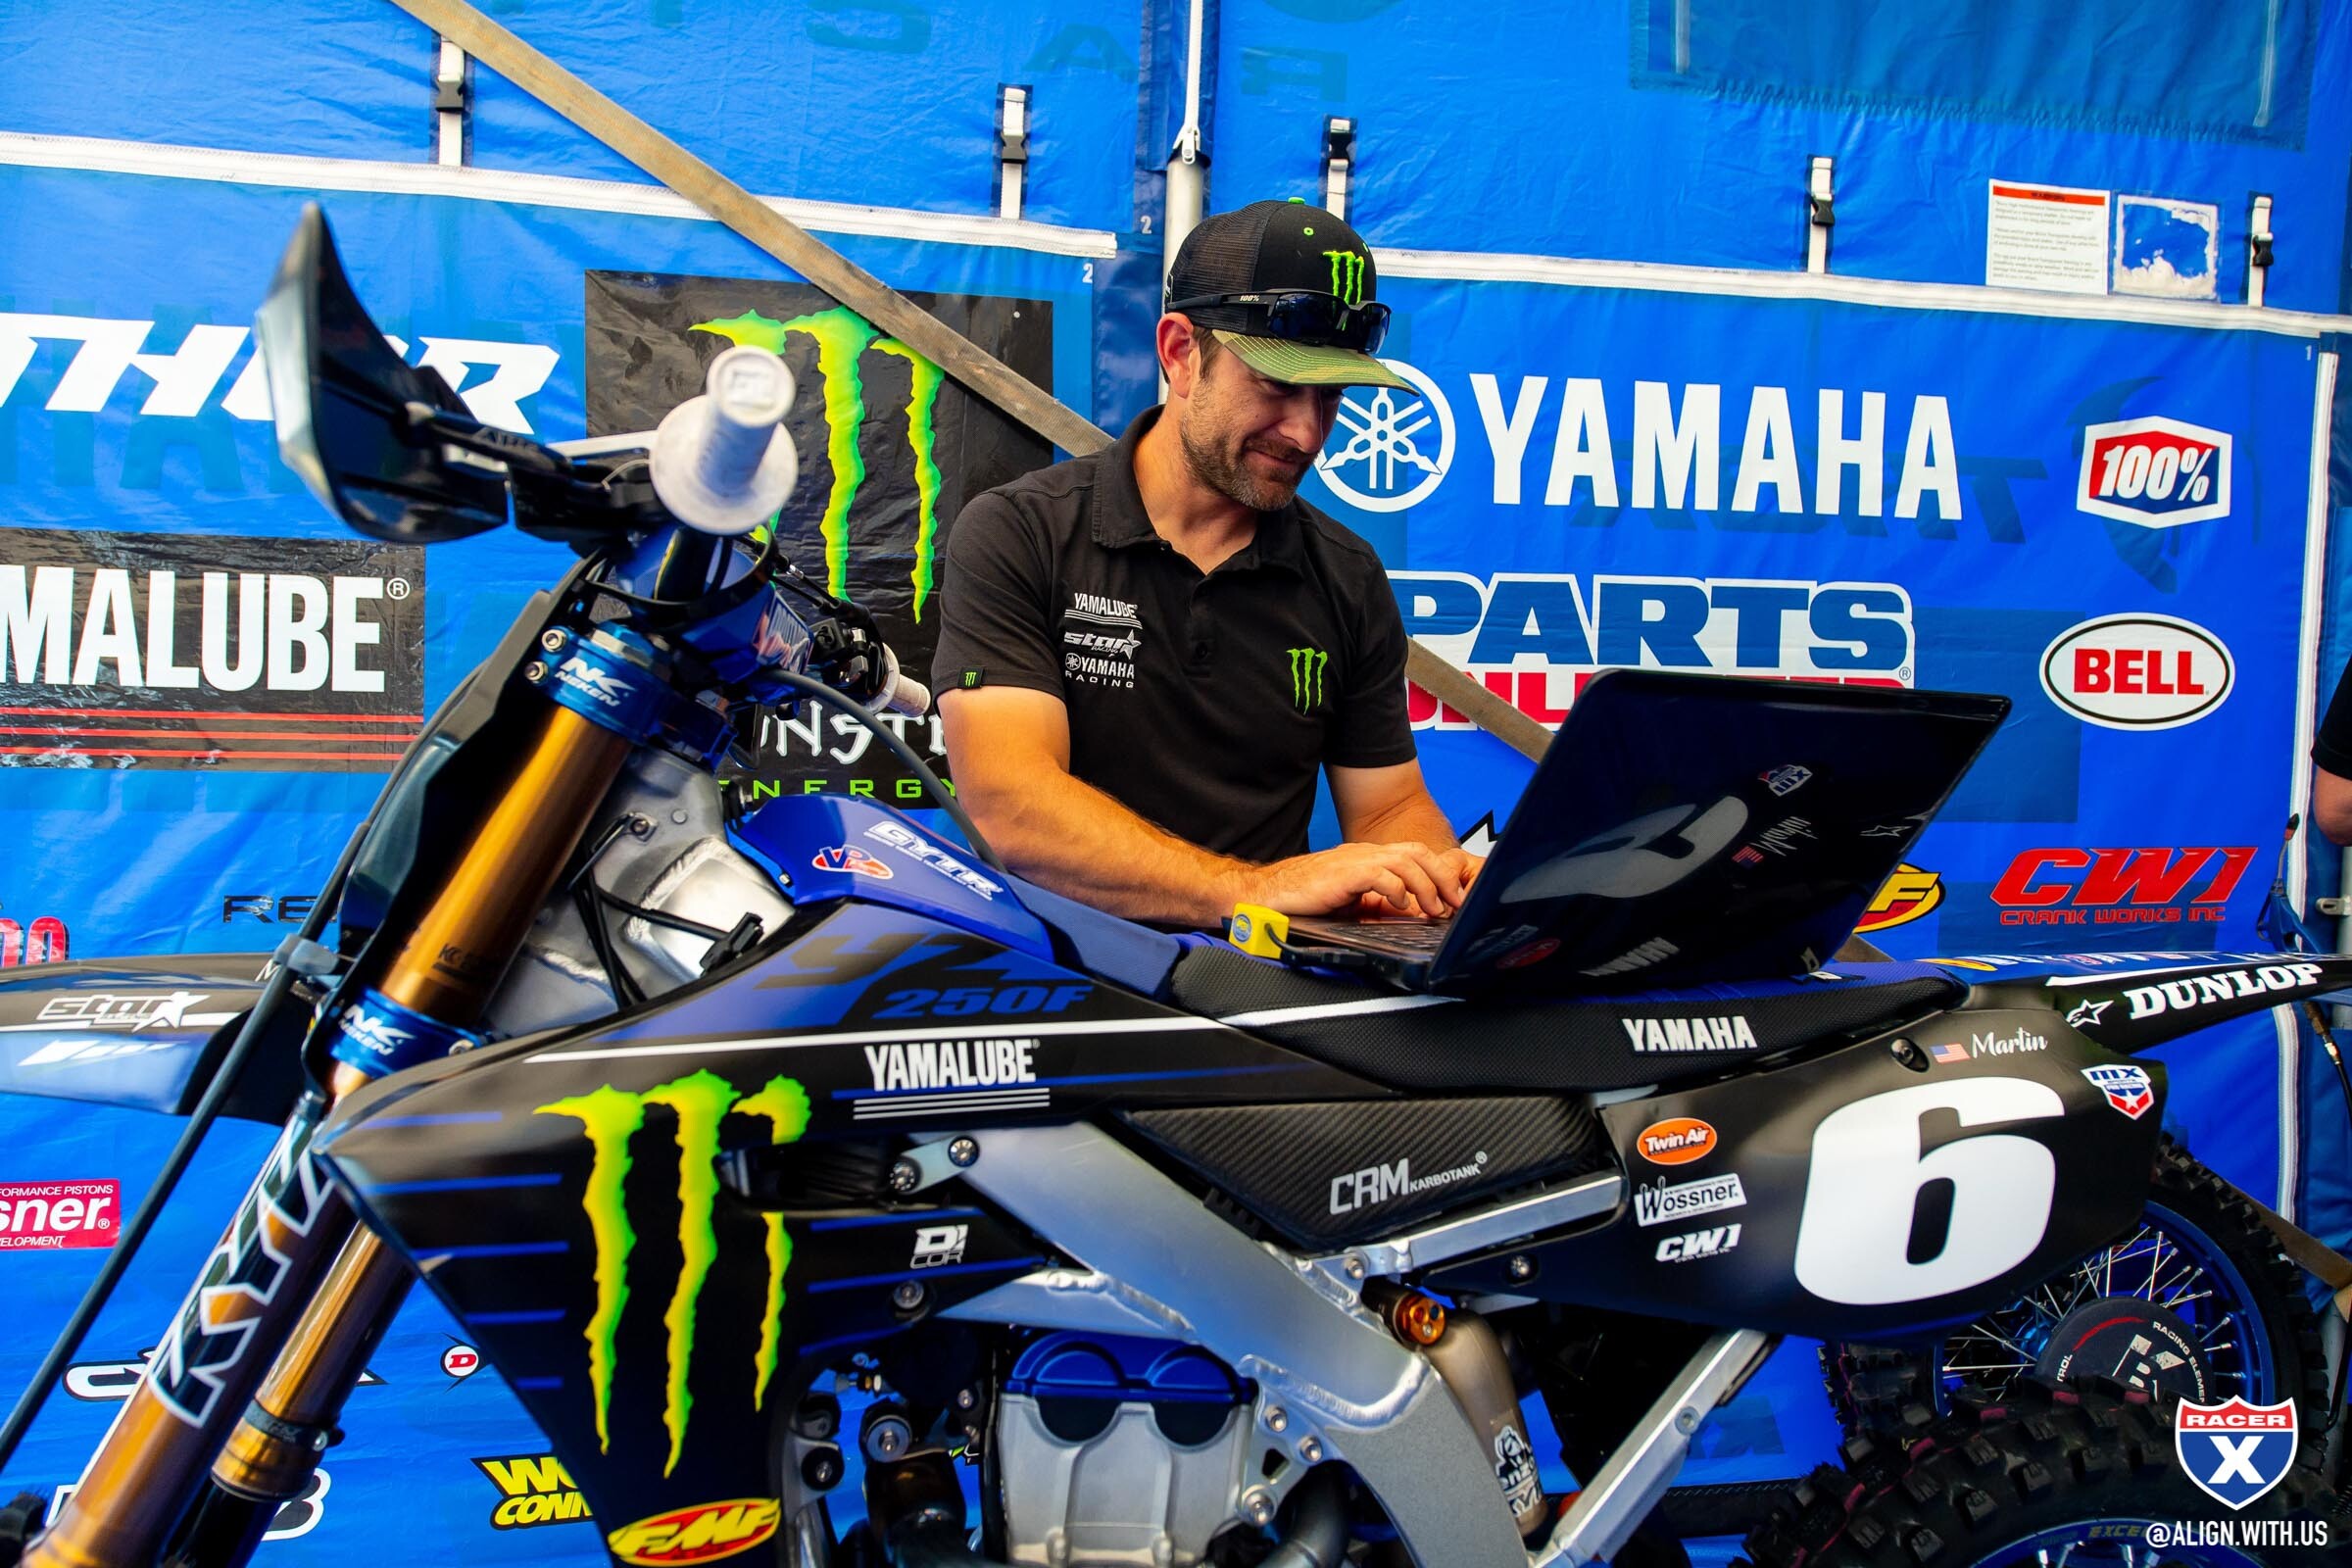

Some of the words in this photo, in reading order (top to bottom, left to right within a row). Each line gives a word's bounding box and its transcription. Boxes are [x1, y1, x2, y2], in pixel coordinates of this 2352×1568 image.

[1140, 215, 1152, 234] 2
[1082, 263, 1094, 284] 2
[1239, 294, 1260, 303] 100%
[1469, 373, 1962, 520] YAMAHA
[2098, 444, 2211, 503] 100%
[1074, 593, 1138, 619] YAMALUBE
[1389, 576, 1911, 672] PARTS
[1064, 670, 1135, 689] RACING
[1081, 657, 1136, 679] YAMAHA
[2074, 648, 2204, 696] BELL
[2000, 908, 2087, 925] CRANK
[2094, 907, 2181, 923] WORKS
[2187, 906, 2226, 922] INC
[871, 986, 1094, 1019] 250F
[2123, 963, 2324, 1020] DUNLOP
[1622, 1015, 1758, 1052] YAMAHA
[1972, 1027, 2048, 1059] Martin
[863, 1040, 1036, 1091] YAMALUBE
[1644, 1133, 1684, 1152] Twin
[1685, 1127, 1710, 1145] Air
[0, 1186, 63, 1198] ORMANCE
[64, 1184, 114, 1196] PISTONS
[1329, 1157, 1409, 1215] CRM
[1409, 1163, 1481, 1193] KARBOTANK
[1794, 1076, 2065, 1306] 6
[0, 1235, 66, 1249] ELOPMENT
[2152, 1321, 2191, 1356] RACING
[608, 1498, 781, 1556] FMF
